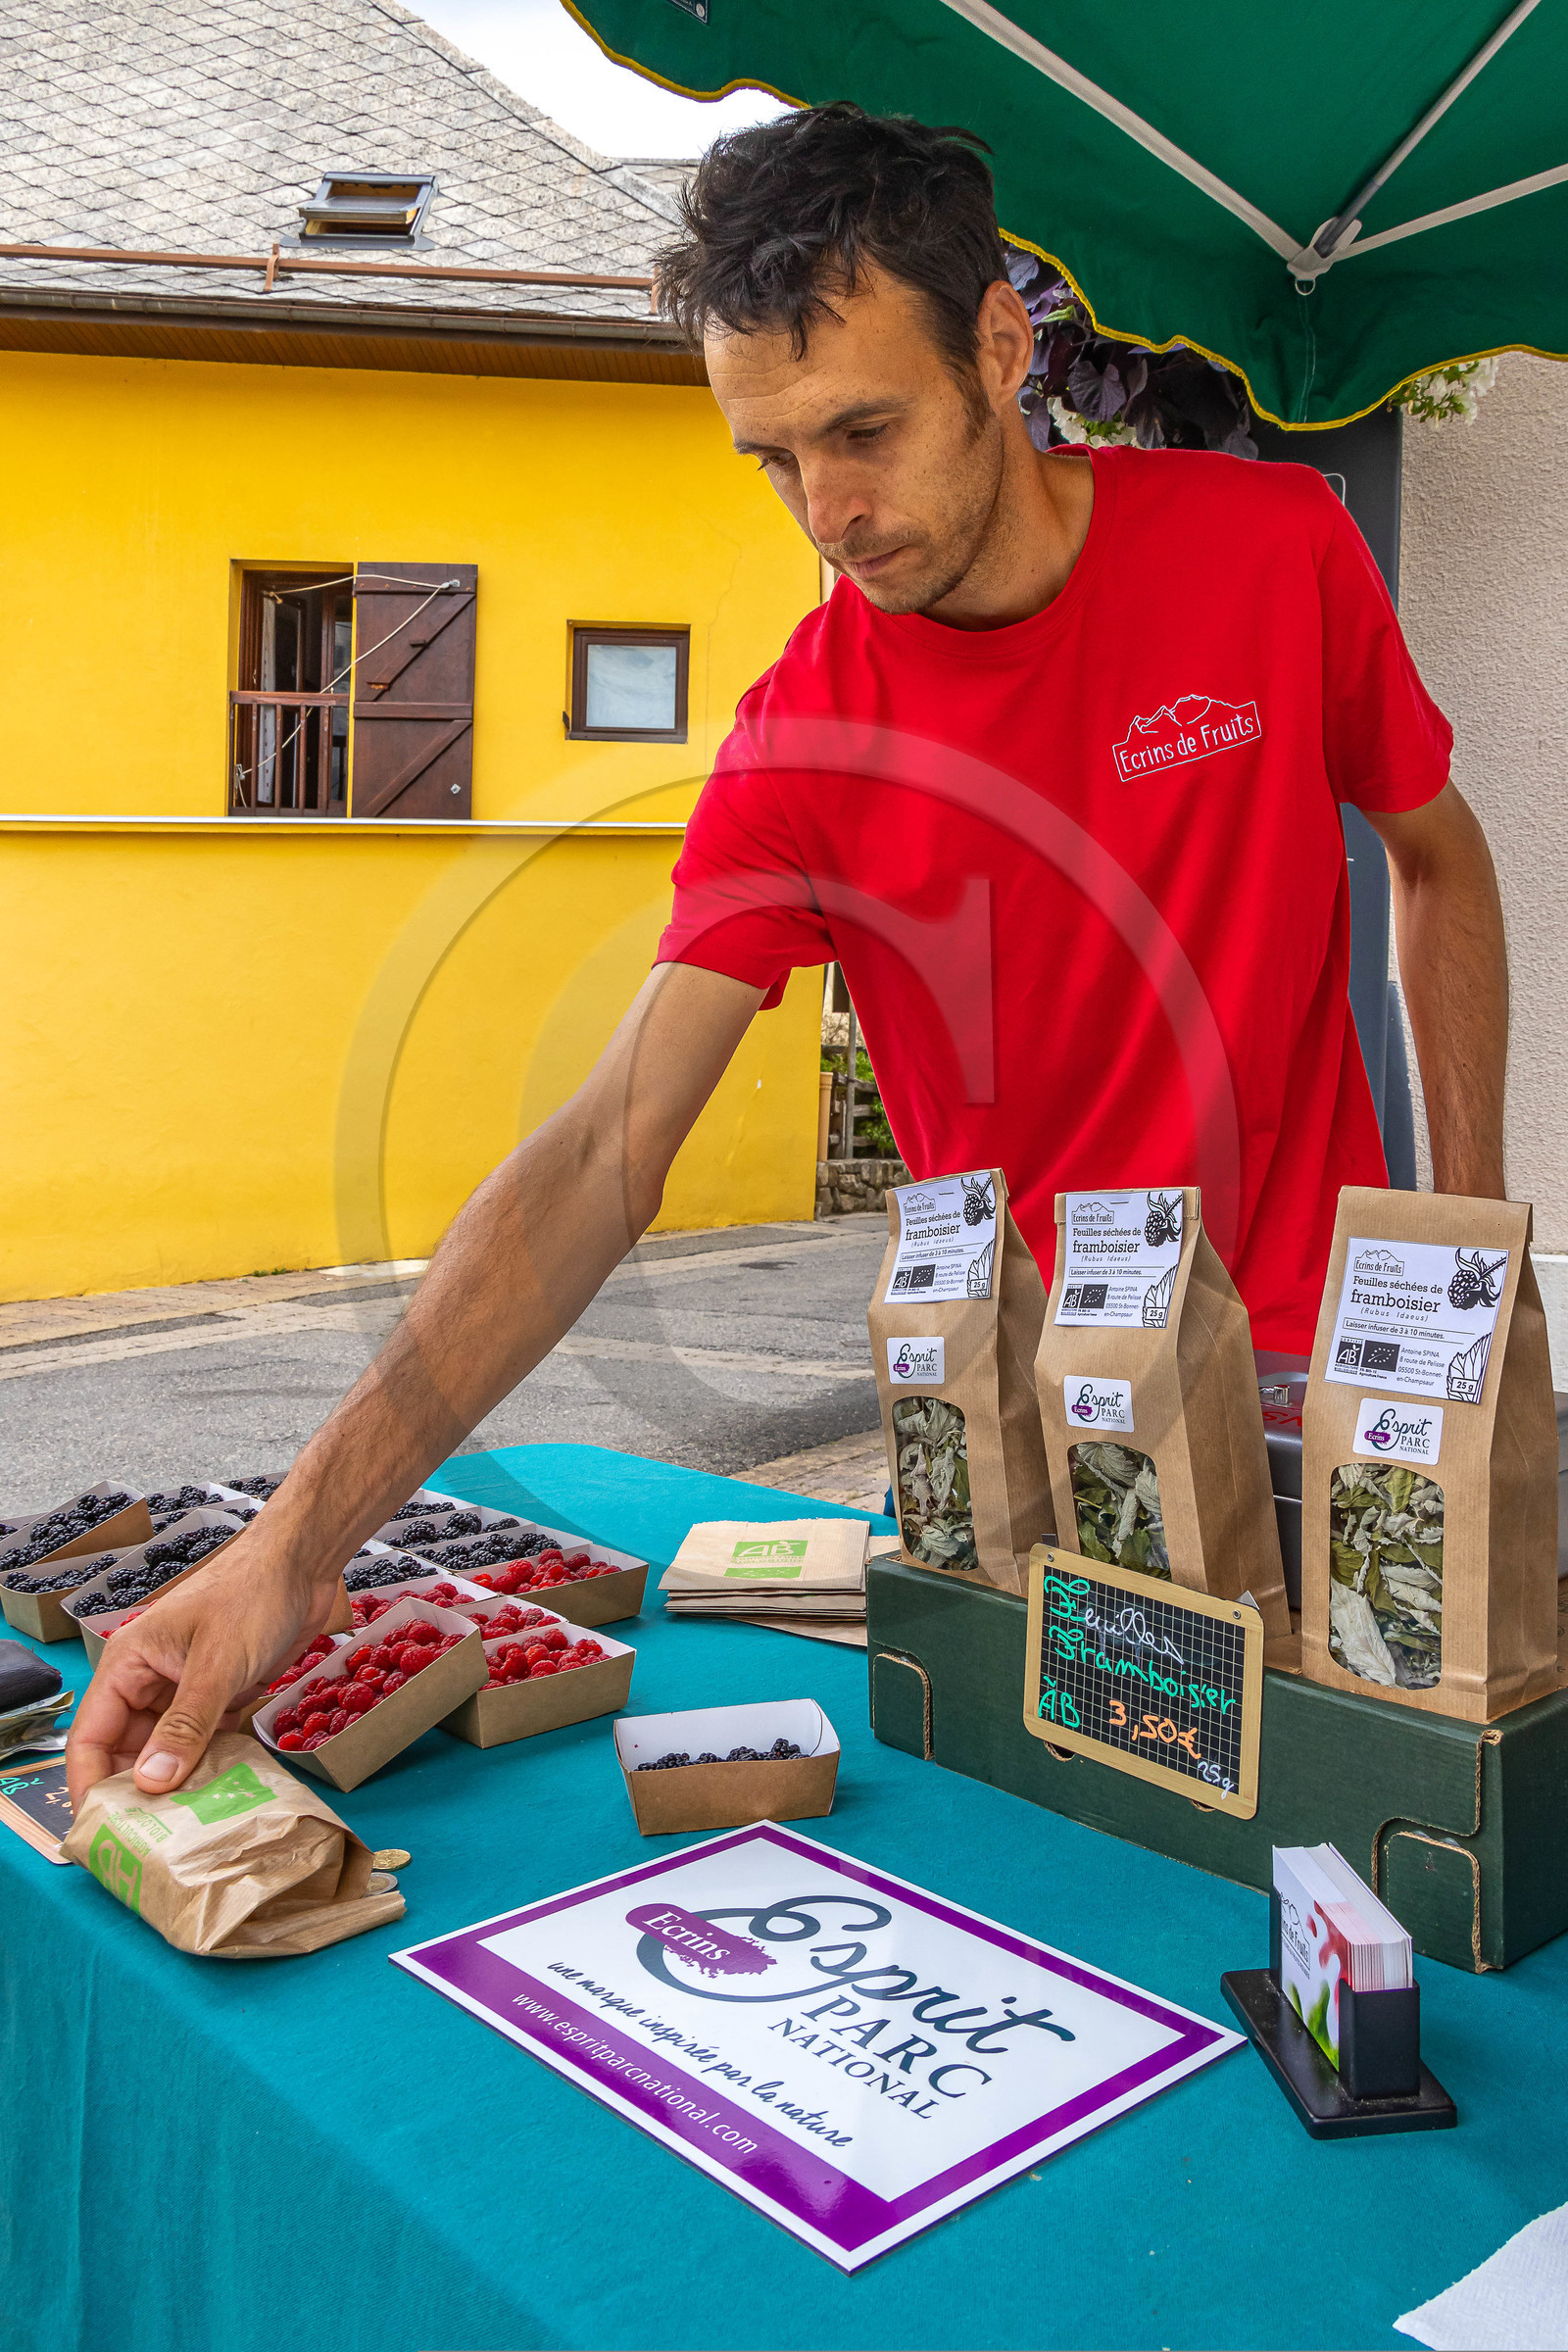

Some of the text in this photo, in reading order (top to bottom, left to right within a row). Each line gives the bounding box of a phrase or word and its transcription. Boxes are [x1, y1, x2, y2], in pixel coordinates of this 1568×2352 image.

[1119, 713, 1254, 772] Ecrins de Fruits
[906, 1210, 960, 1226] Feuilles séchées de
[1096, 1213, 1112, 1222] Fruits
[905, 1224, 961, 1241] framboisier
[1072, 1240, 1141, 1253] framboisier
[1355, 1260, 1402, 1273] Ecrins de Fruits
[893, 1275, 907, 1288] AB
[1352, 1275, 1444, 1294] Feuilles séchées de
[1063, 1293, 1077, 1307] AB
[1349, 1289, 1442, 1313] framboisier
[1360, 1306, 1429, 1322] (Rubus Idaeus)
[1346, 1320, 1367, 1330] Laisser
[1367, 1324, 1389, 1333] infuser
[1418, 1330, 1445, 1340] minutes.
[897, 1344, 937, 1374] Esprit
[1337, 1348, 1356, 1364] AB
[1401, 1348, 1422, 1356] Antoine
[916, 1363, 937, 1372] PARC
[1396, 1376, 1435, 1386] en-Champsaur
[1456, 1381, 1467, 1390] 25
[1076, 1384, 1123, 1417] Esprit
[1102, 1408, 1125, 1418] PARC
[1372, 1408, 1433, 1445] Esprit
[1367, 1432, 1385, 1442] Ecrins
[1400, 1435, 1431, 1448] PARC
[1399, 1446, 1430, 1455] NATIONAL
[738, 1543, 794, 1557] AB
[1044, 1575, 1185, 1666] Feuilles
[1049, 1625, 1236, 1715] Framboisier
[1108, 1698, 1201, 1759] 3,50€
[642, 1910, 731, 1960] Ecrins
[637, 1894, 1076, 2054] Esprit
[547, 1961, 854, 2147] une marque inspirée par la nature
[801, 1994, 992, 2099] PARC
[512, 1993, 759, 2155] www.espritparcnational.com
[767, 2017, 940, 2120] NATIONAL
